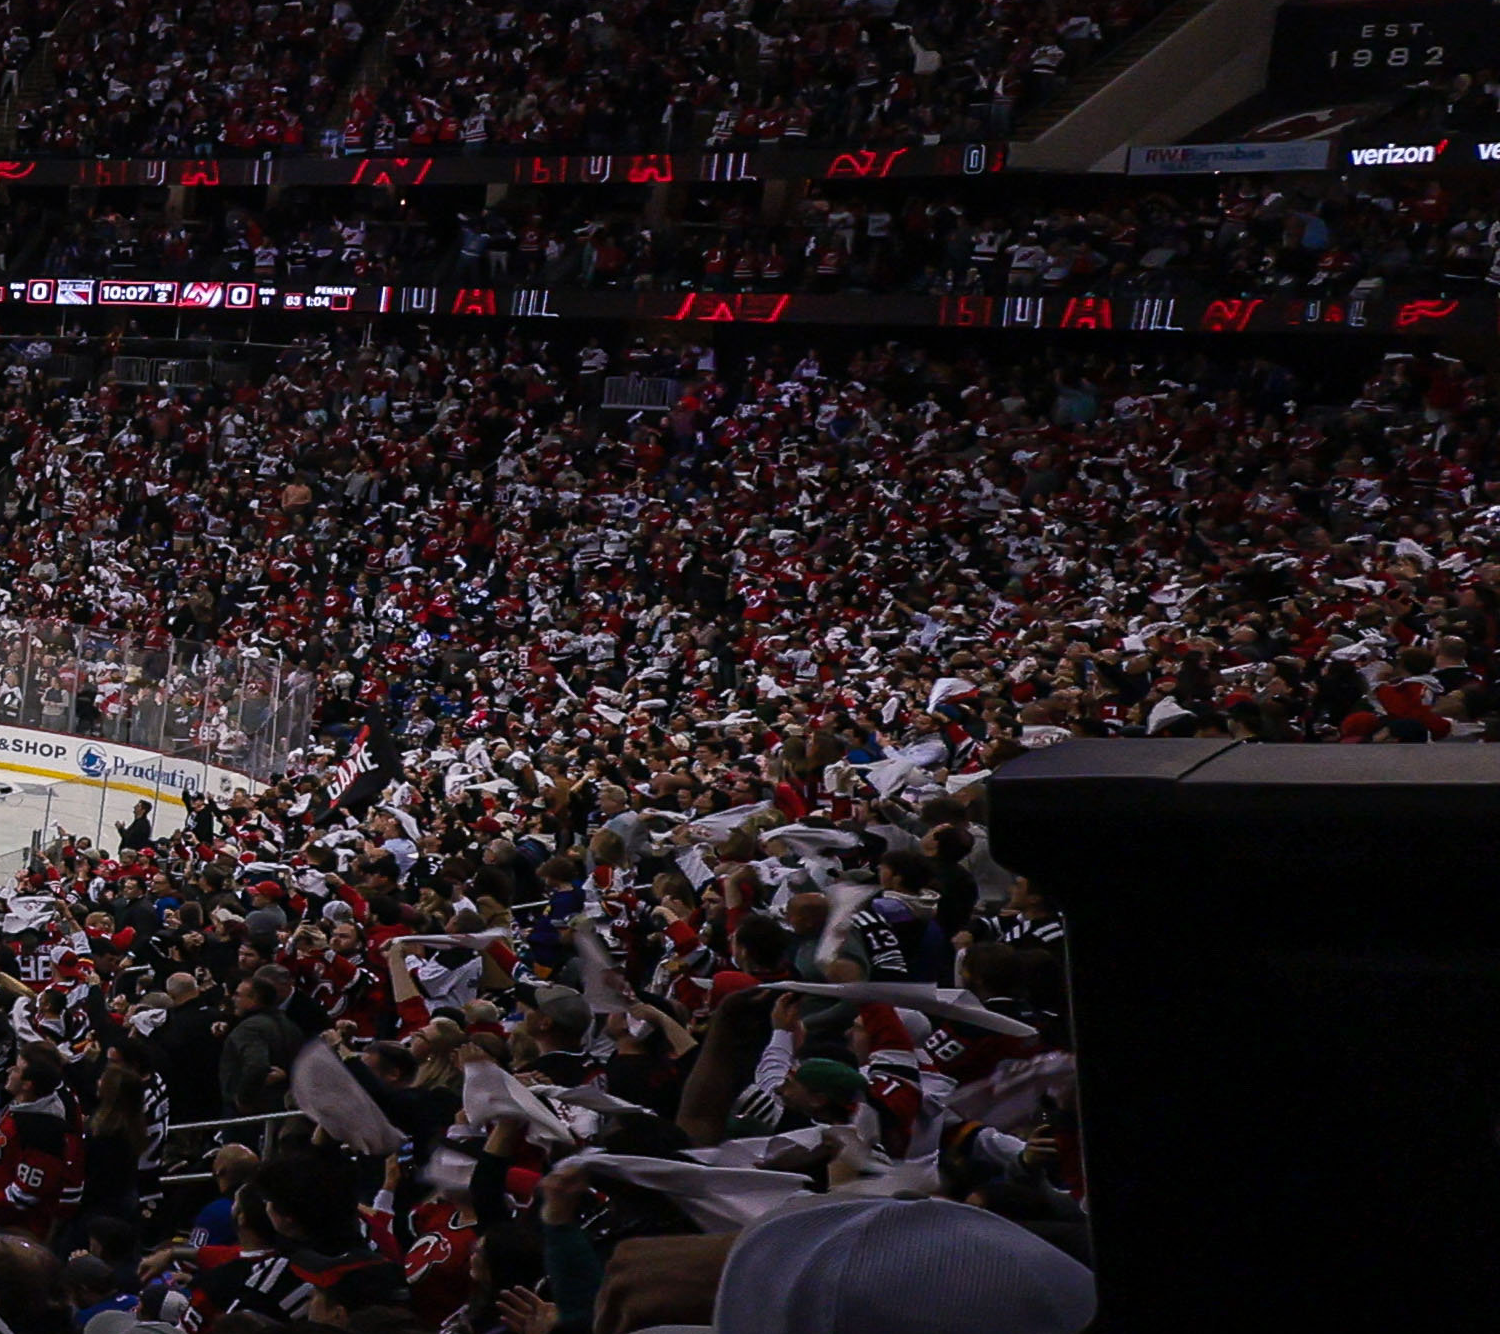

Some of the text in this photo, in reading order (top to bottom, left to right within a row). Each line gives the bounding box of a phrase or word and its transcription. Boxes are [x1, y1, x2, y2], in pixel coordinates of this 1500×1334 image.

[1361, 22, 1433, 38] EST.
[1329, 47, 1444, 68] 1982
[1351, 143, 1435, 165] verizon
[32, 284, 47, 300] 0
[103, 286, 149, 300] 10:07
[157, 292, 168, 303] 2
[231, 287, 248, 304] 0
[306, 296, 329, 307] 1:04
[112, 756, 200, 791] Prudential
[867, 929, 899, 950] 13
